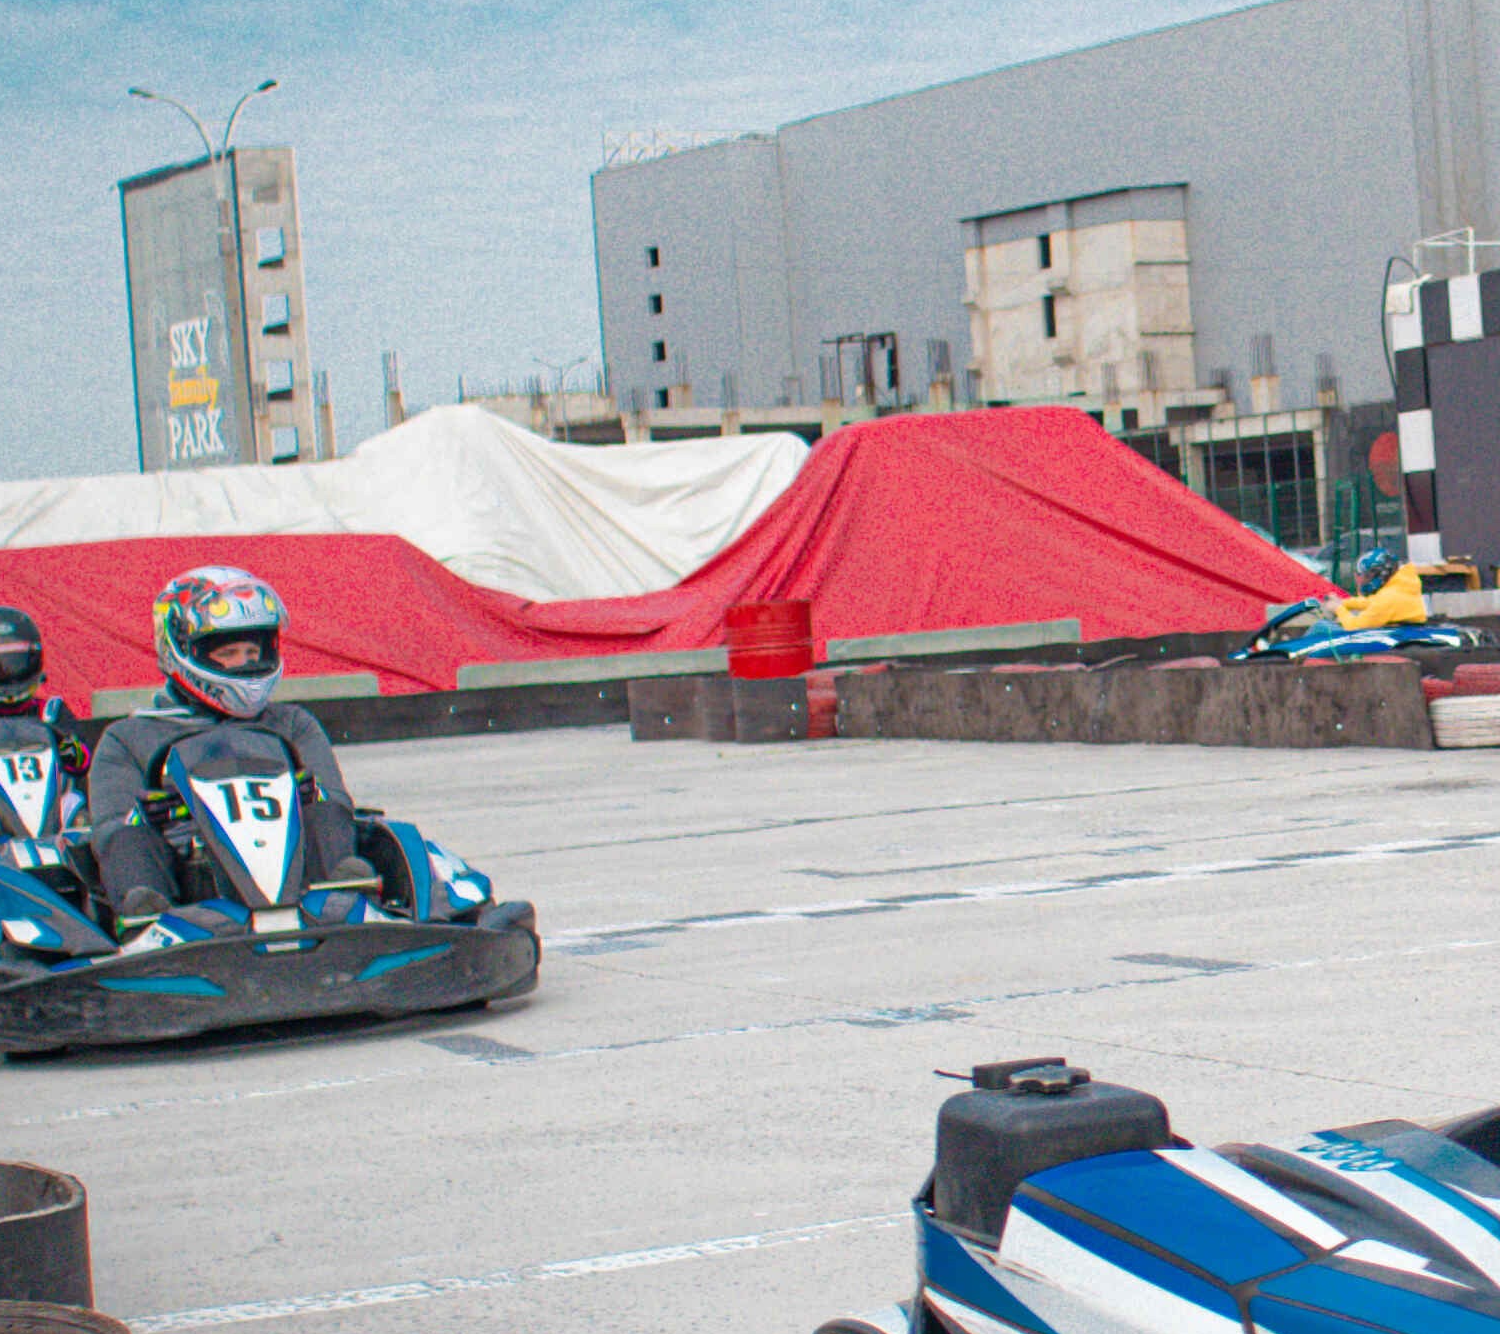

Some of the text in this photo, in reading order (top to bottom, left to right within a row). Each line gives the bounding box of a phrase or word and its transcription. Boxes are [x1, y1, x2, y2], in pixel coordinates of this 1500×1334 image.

[170, 317, 212, 368] SKY
[168, 408, 226, 460] PARK
[1, 754, 44, 784] 13
[217, 780, 283, 823] 15
